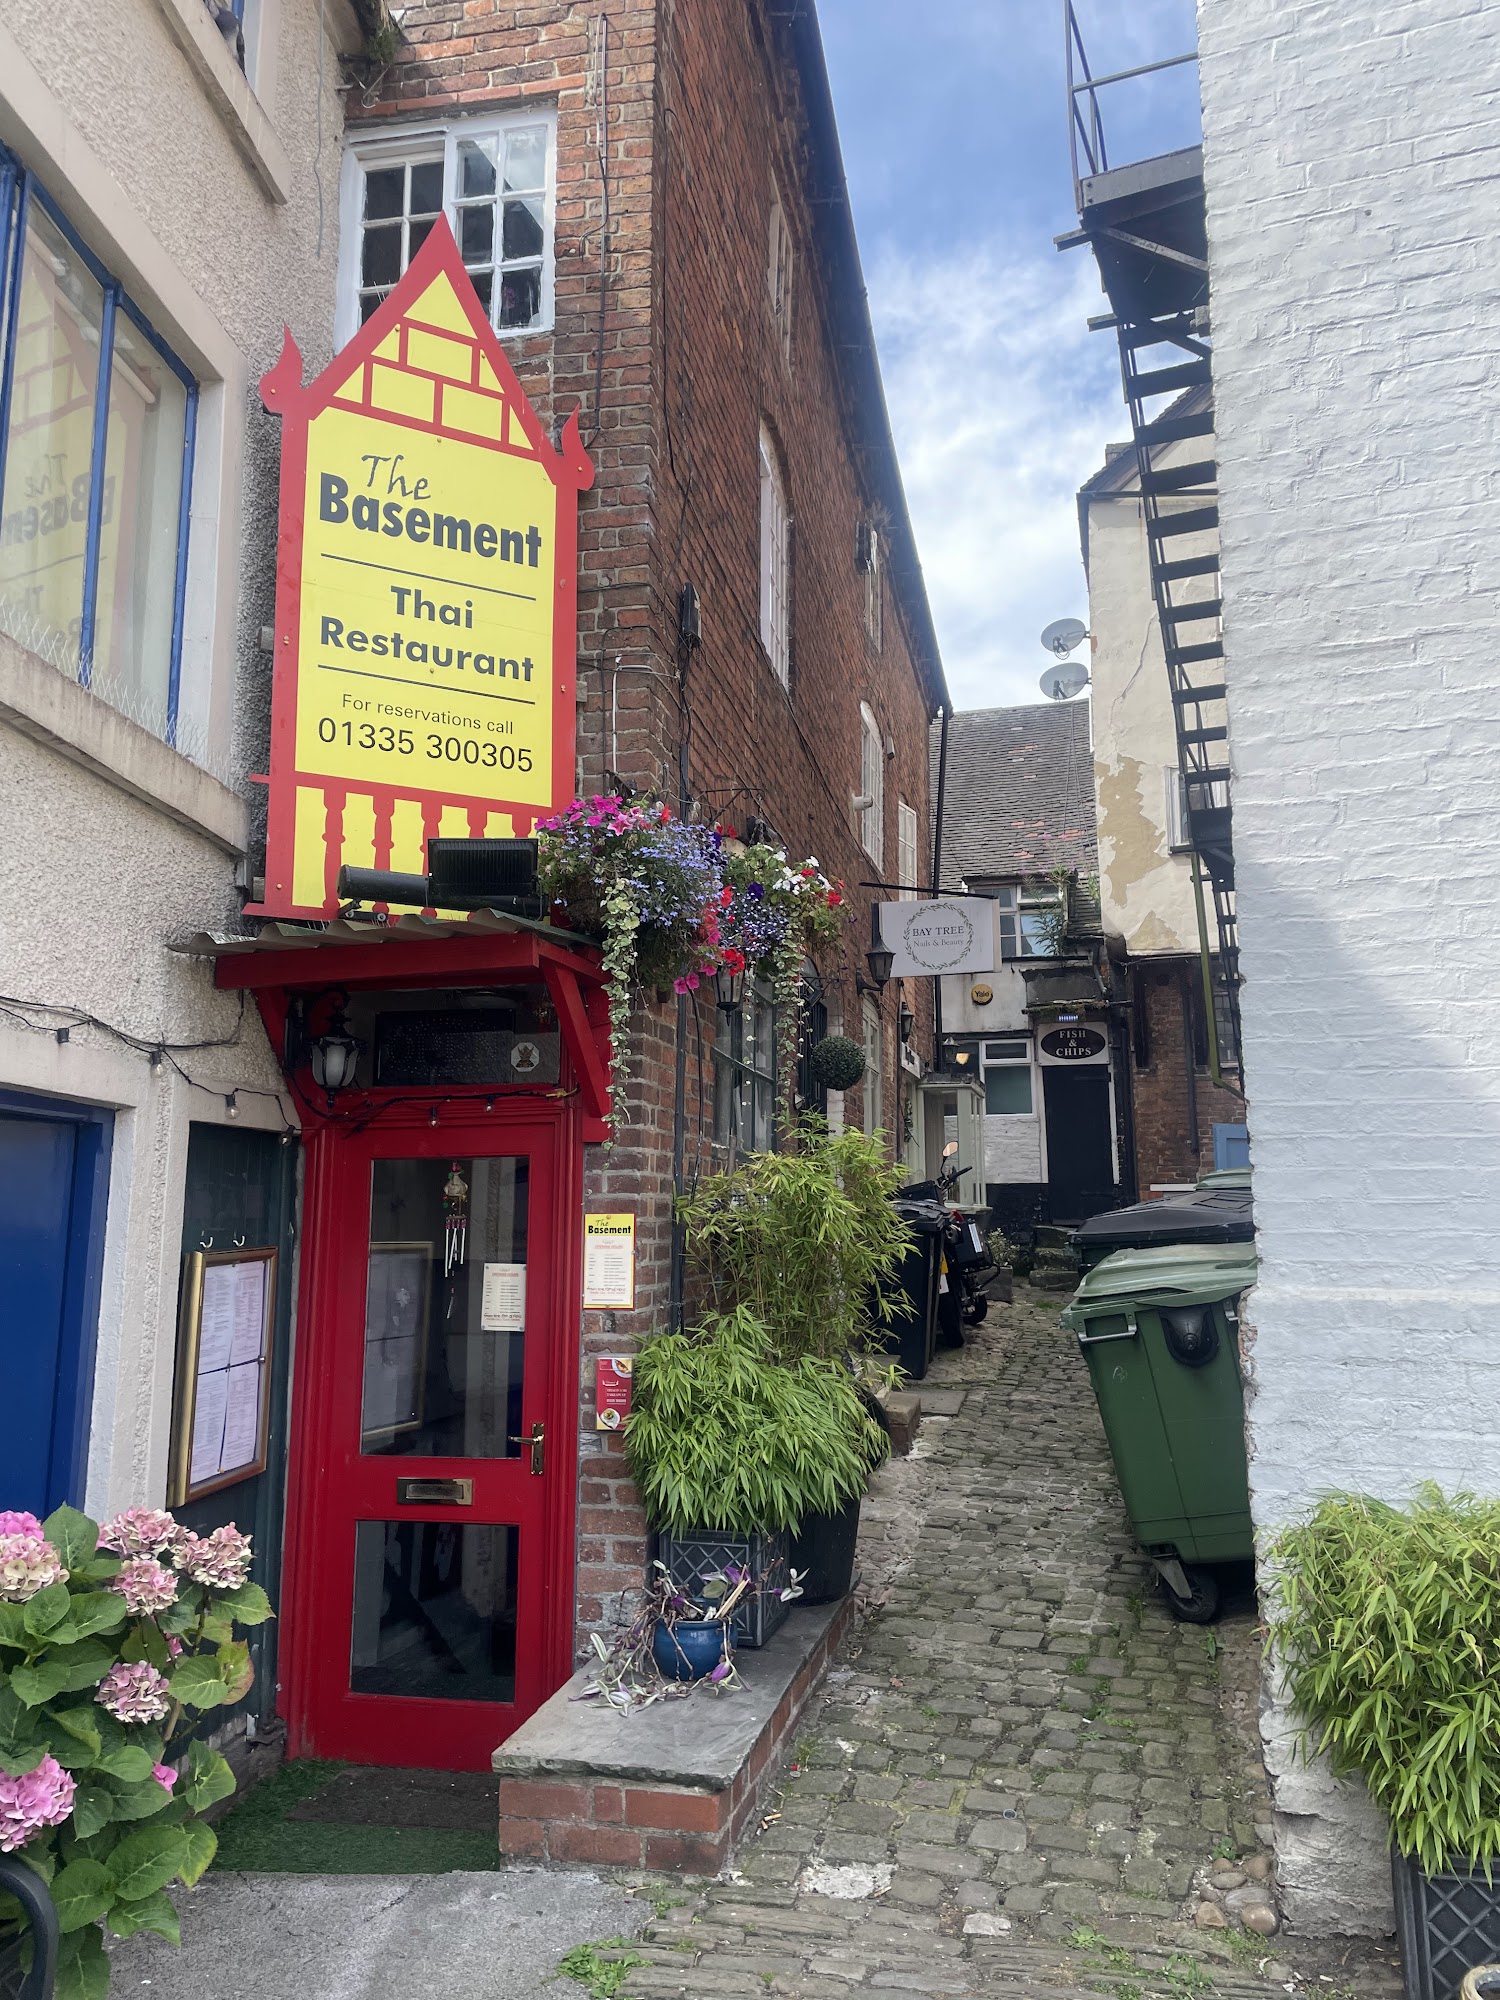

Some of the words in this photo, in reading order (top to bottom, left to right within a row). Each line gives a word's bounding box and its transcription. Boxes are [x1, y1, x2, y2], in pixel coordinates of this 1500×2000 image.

[361, 454, 431, 500] The
[319, 471, 542, 568] Basement
[390, 585, 473, 629] Thai
[320, 615, 534, 682] Restaurant
[342, 693, 371, 711] For
[377, 702, 481, 729] reservations
[487, 719, 514, 735] call
[318, 717, 415, 755] 01335
[426, 734, 533, 772] 300305
[912, 927, 932, 937] BAY
[935, 925, 965, 936] TREE
[913, 940, 931, 948] Nails
[932, 939, 939, 947] &
[941, 938, 964, 948] Beauty
[1059, 1029, 1086, 1039] FISH
[1068, 1038, 1077, 1047] &
[1055, 1047, 1092, 1057] CHIPS
[595, 1218, 609, 1227] The
[588, 1225, 631, 1234] Basement
